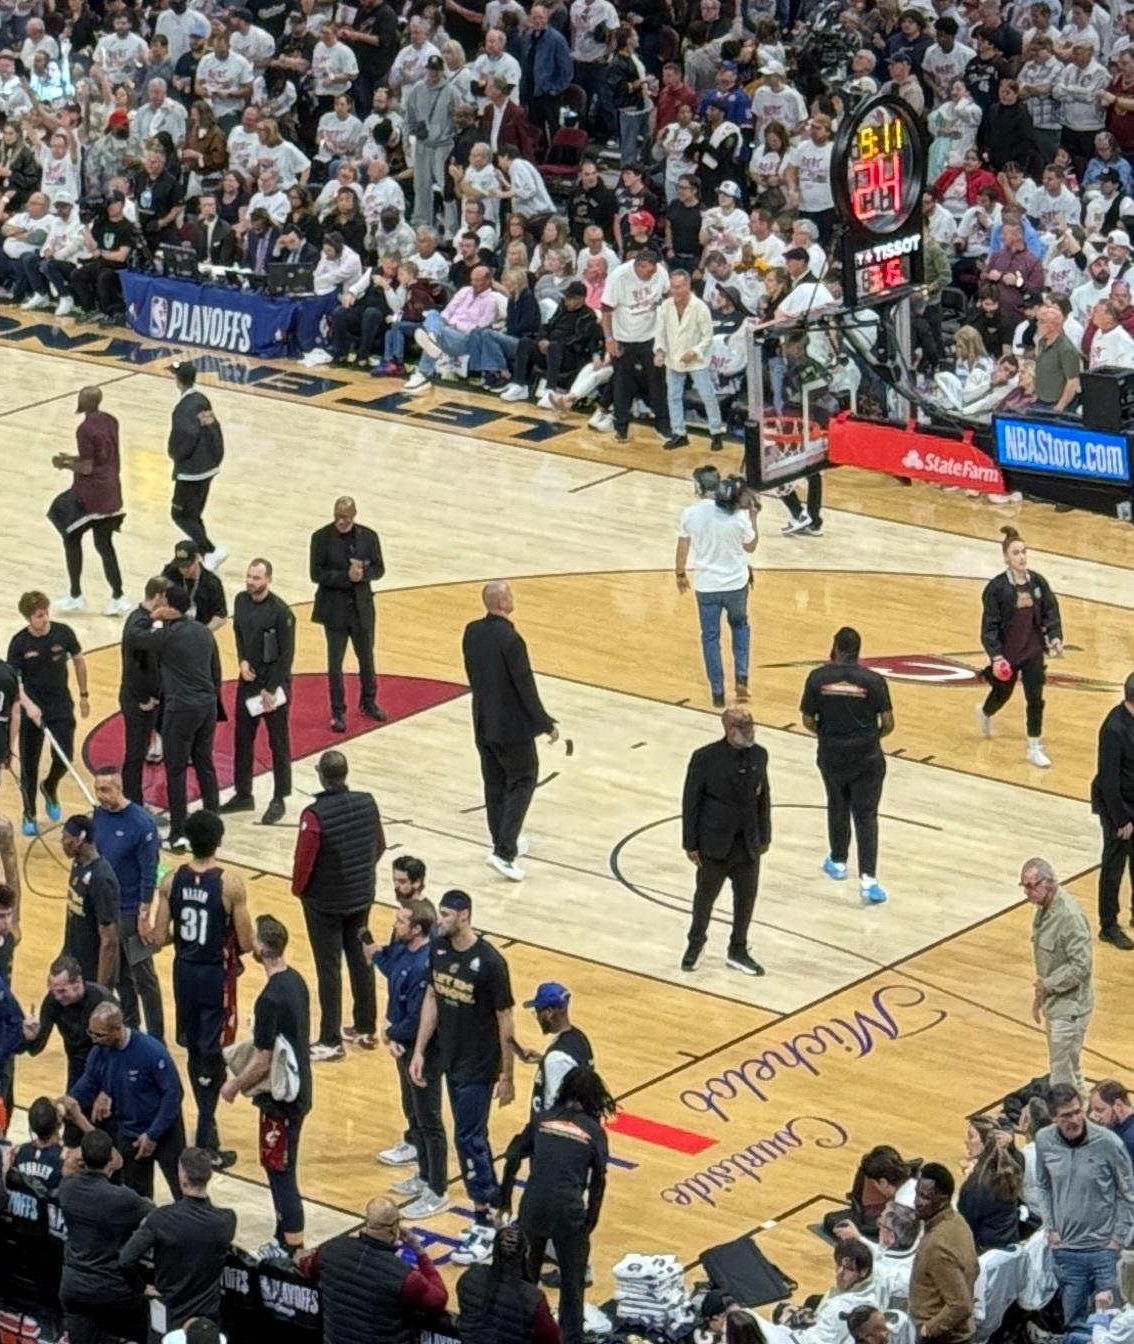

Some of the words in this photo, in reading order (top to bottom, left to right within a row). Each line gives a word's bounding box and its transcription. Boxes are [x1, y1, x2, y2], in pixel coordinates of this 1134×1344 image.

[852, 152, 902, 221] 24
[873, 234, 922, 263] TISSOT
[168, 302, 253, 354] PLAYOFFS
[1004, 426, 1125, 475] NBAStore.com
[180, 906, 208, 945] 31
[680, 983, 948, 1123] Michelob
[660, 1114, 849, 1209] Courtside
